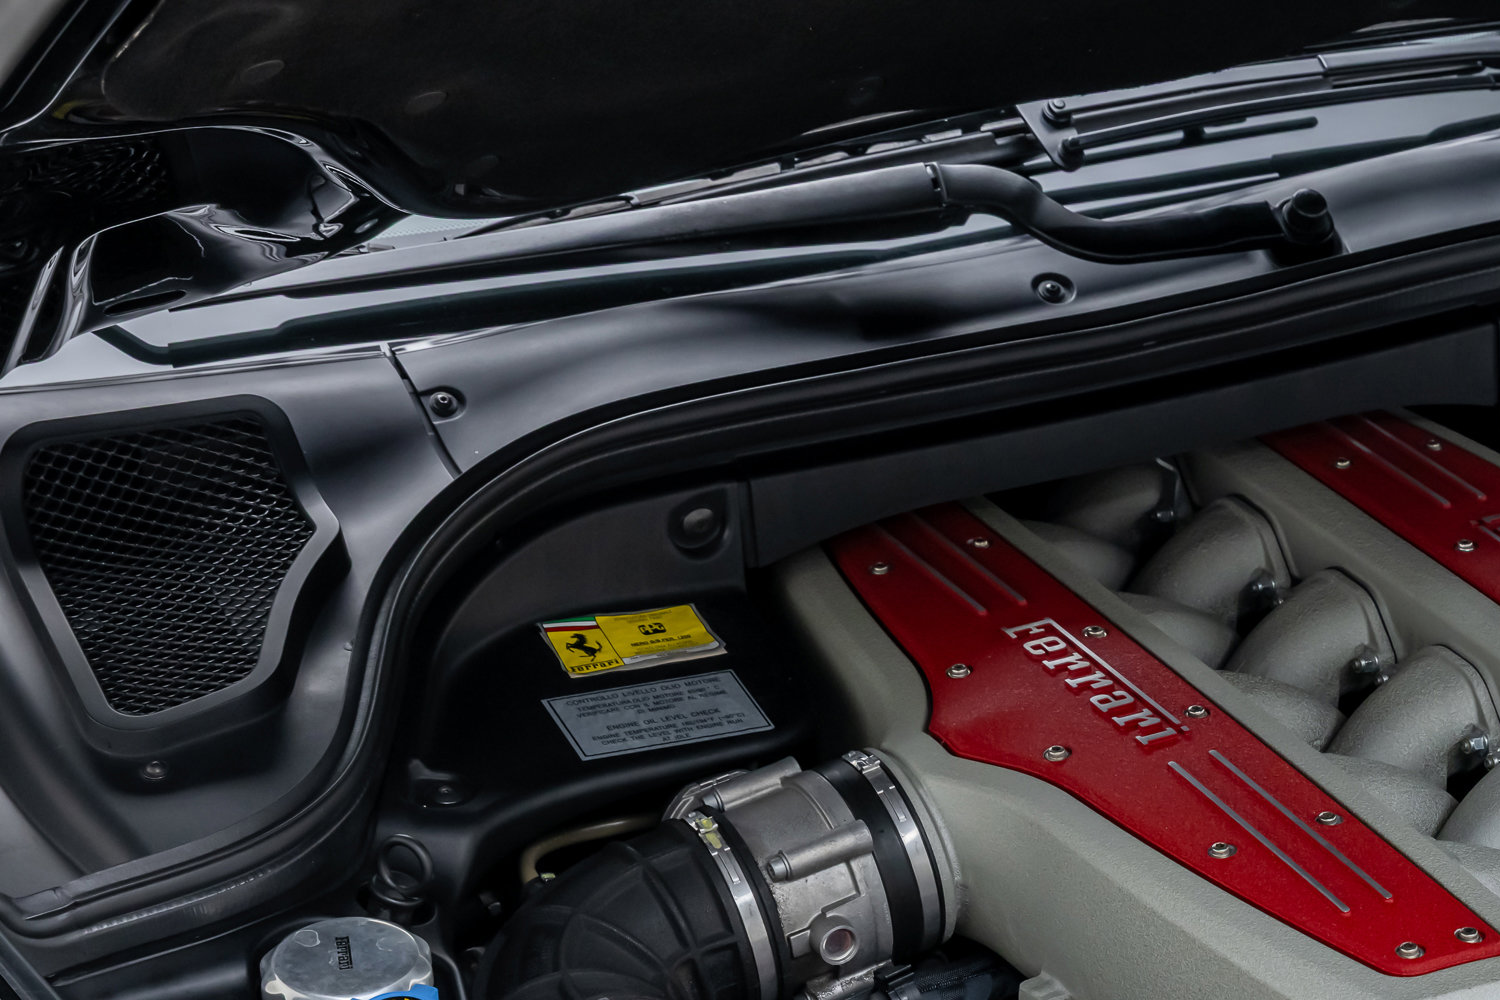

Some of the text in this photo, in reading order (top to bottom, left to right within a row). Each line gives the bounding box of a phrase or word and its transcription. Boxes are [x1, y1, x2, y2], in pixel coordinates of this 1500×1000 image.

[569, 658, 620, 673] Ferrari
[565, 693, 619, 706] CONTROLLO
[621, 687, 657, 697] LIVELLO
[683, 676, 721, 687] MOTORE
[1001, 617, 1190, 745] Ferrari
[605, 721, 640, 731] ENGINE
[659, 712, 688, 722] LEVEL
[688, 707, 721, 717] CHECK
[335, 936, 353, 970] Ferrari
